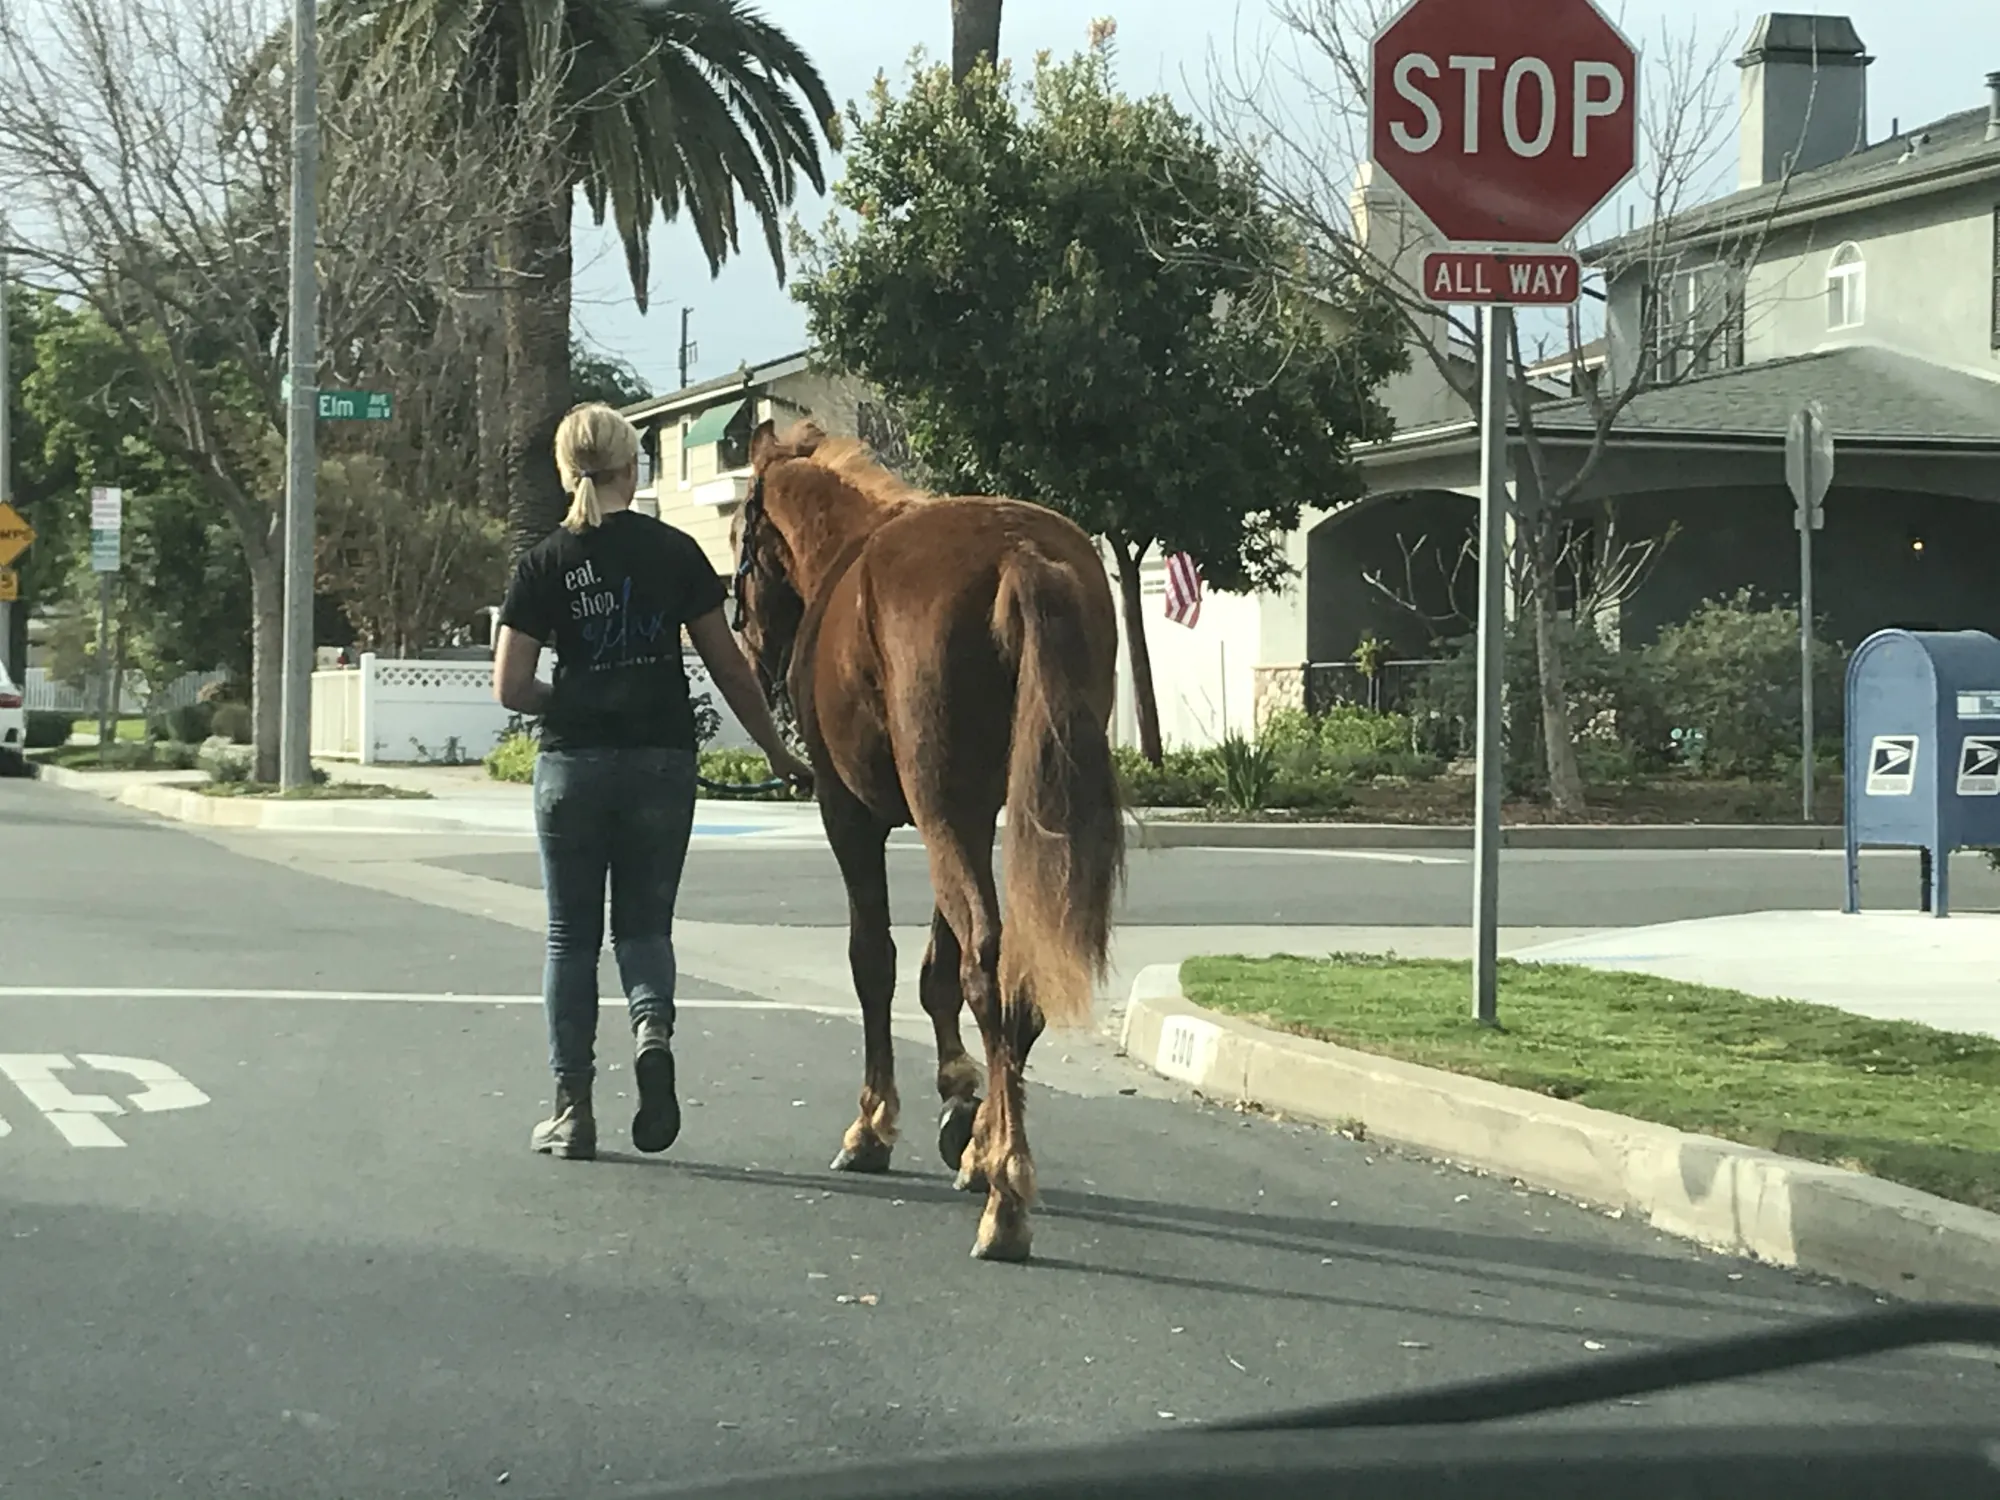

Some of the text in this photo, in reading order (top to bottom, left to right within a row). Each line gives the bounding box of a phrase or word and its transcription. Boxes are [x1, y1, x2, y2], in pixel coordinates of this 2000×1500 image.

[1388, 52, 1625, 158] STOP
[1433, 262, 1568, 295] ALL WAY
[319, 394, 354, 417] Elm
[565, 559, 602, 591] eat.
[570, 591, 620, 620] shop.
